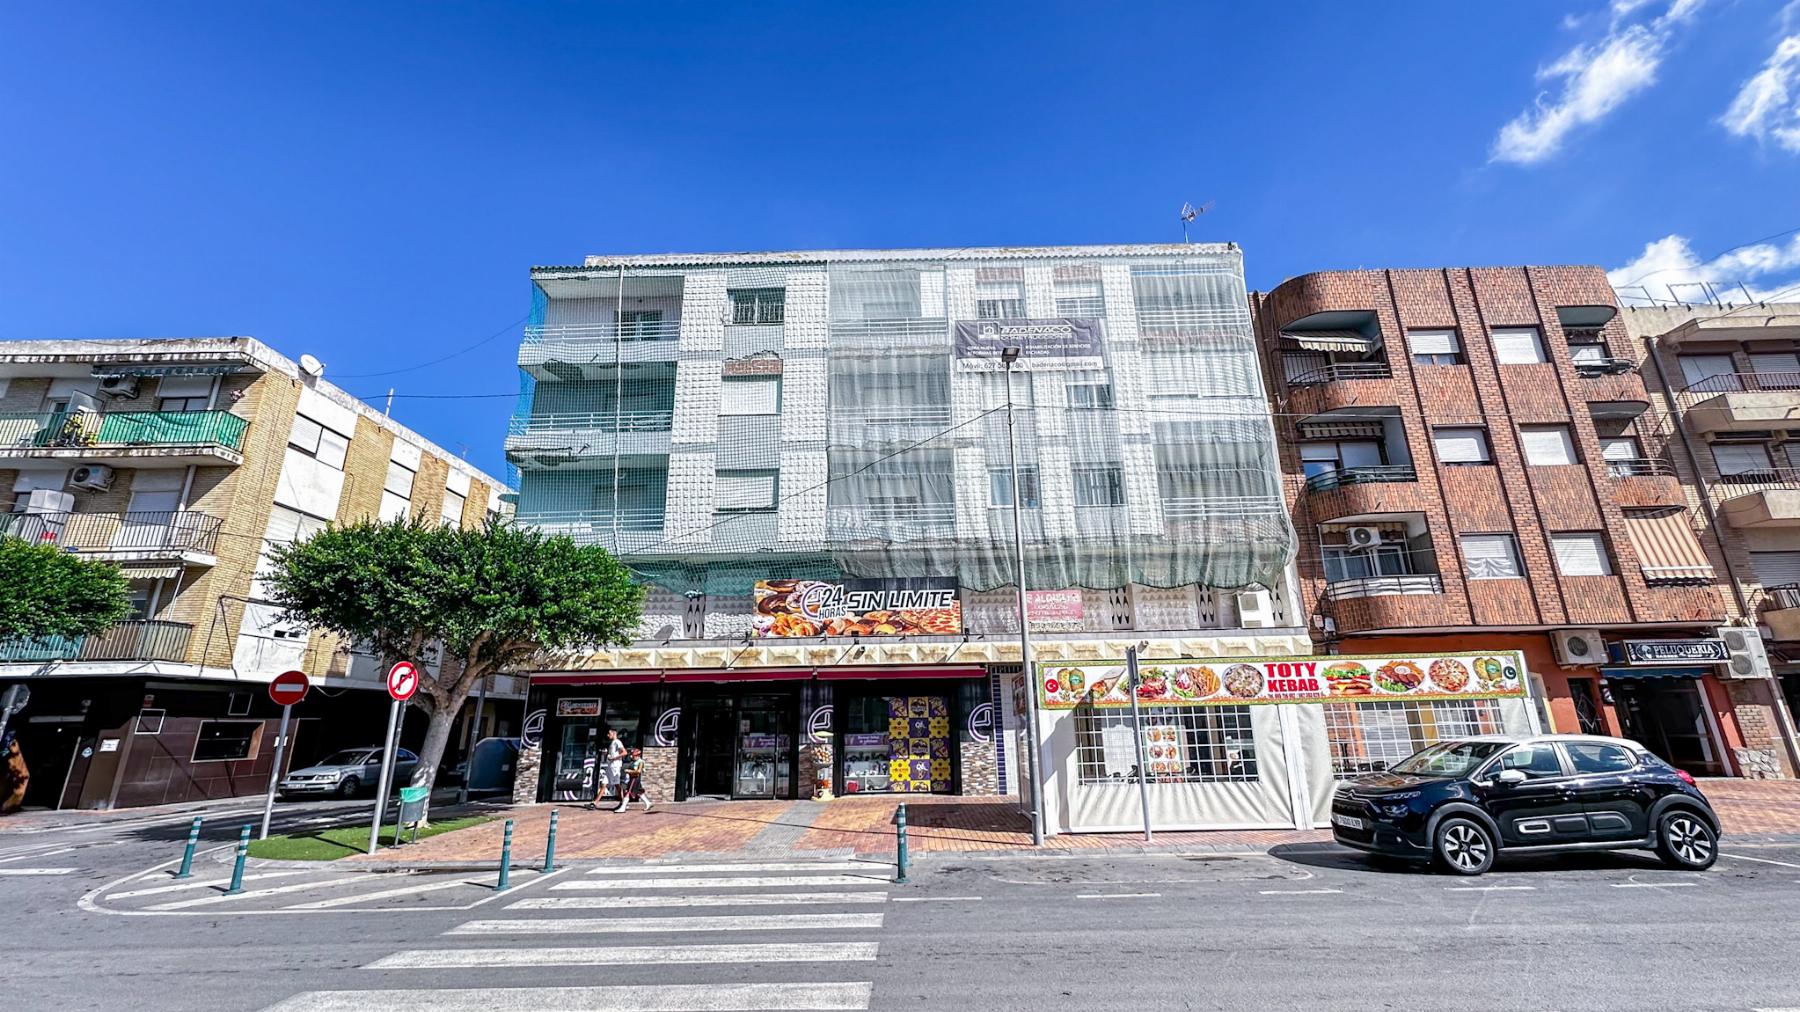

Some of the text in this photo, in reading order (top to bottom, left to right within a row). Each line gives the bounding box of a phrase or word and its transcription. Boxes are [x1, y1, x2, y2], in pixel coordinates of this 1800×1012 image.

[1001, 326, 1072, 335] BADENACO
[822, 585, 845, 607] 24
[848, 589, 954, 610] SIN LIMITE
[819, 606, 847, 620] HORAS
[1653, 645, 1715, 656] PELUQUERIA
[1263, 662, 1317, 678] TOTY
[1267, 678, 1320, 692] KEBAB
